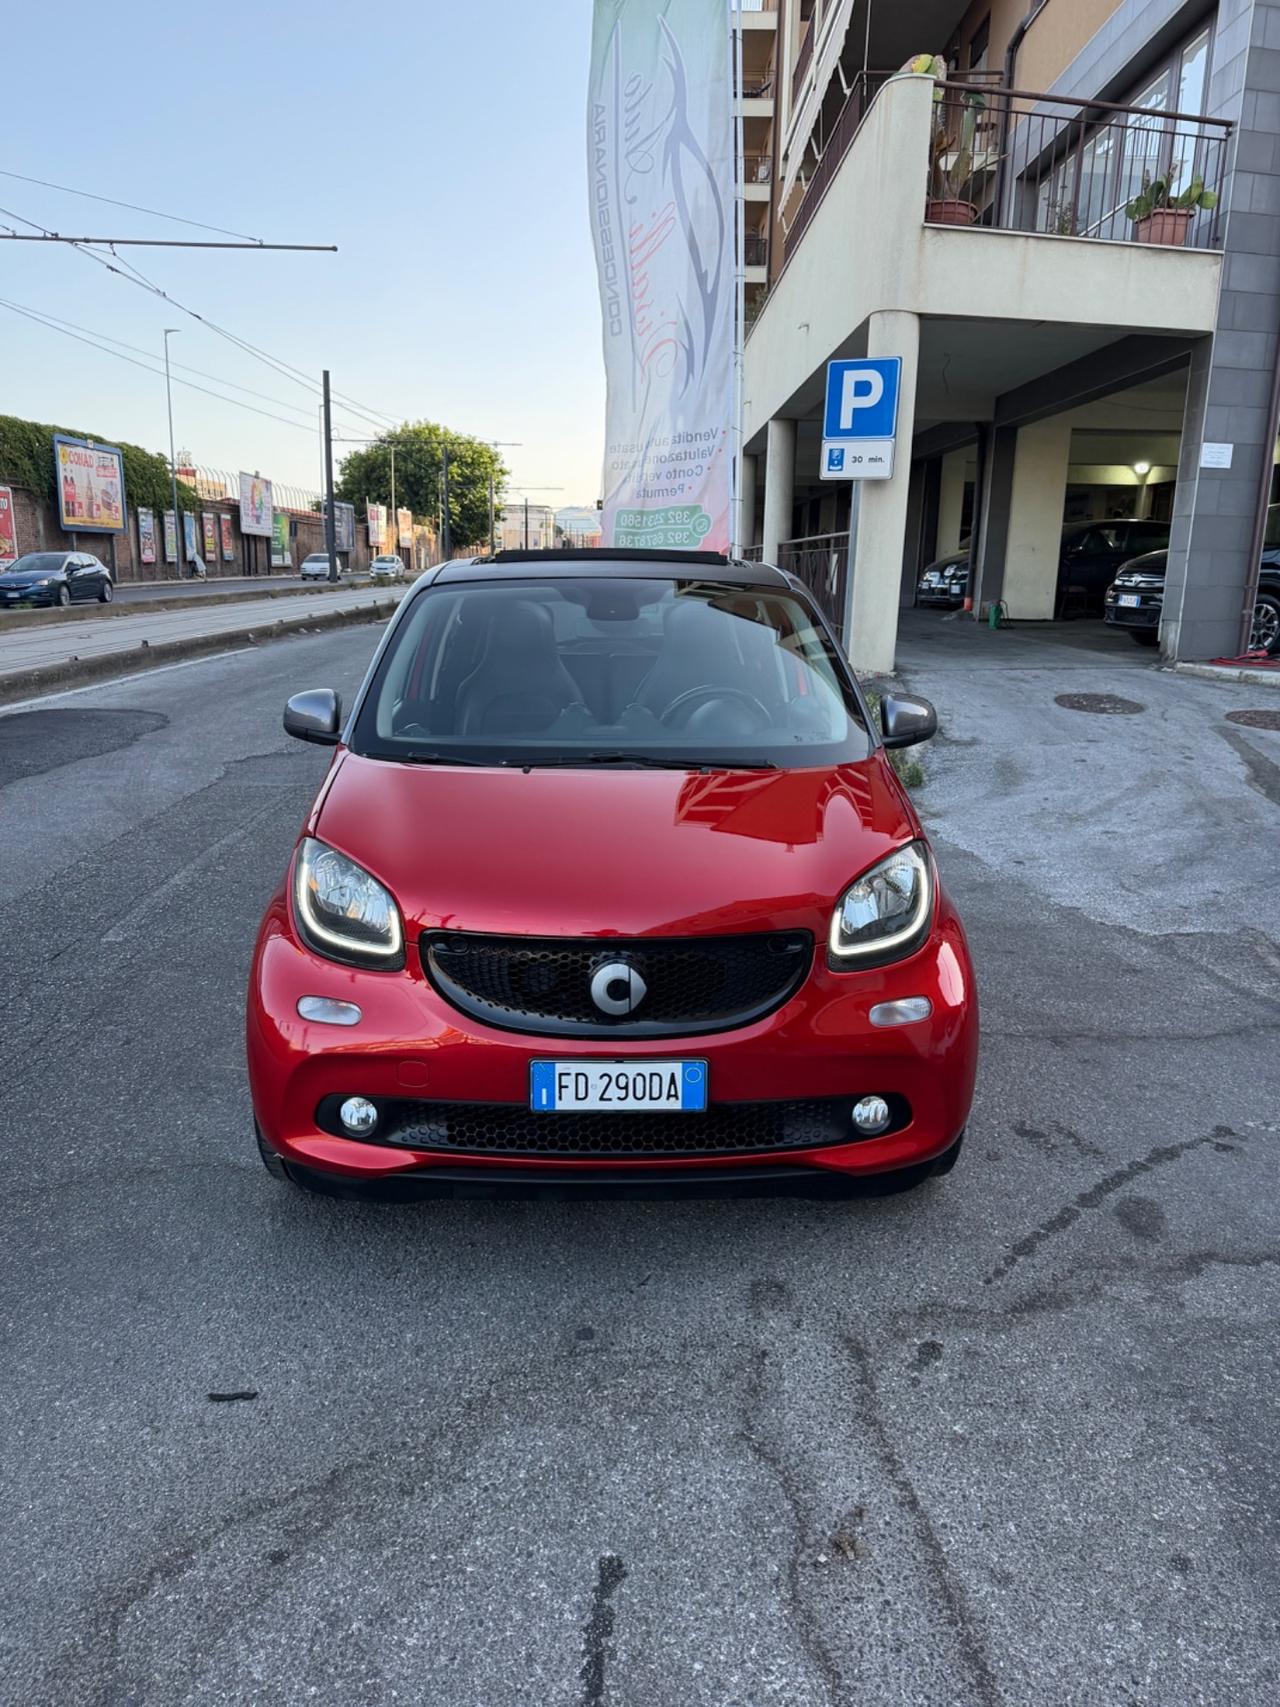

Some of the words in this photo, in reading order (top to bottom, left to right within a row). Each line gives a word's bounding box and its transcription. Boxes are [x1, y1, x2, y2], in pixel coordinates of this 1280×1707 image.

[839, 369, 884, 429] P
[851, 455, 864, 464] 30
[558, 1072, 589, 1102] FD
[599, 1072, 680, 1102] 290DA
